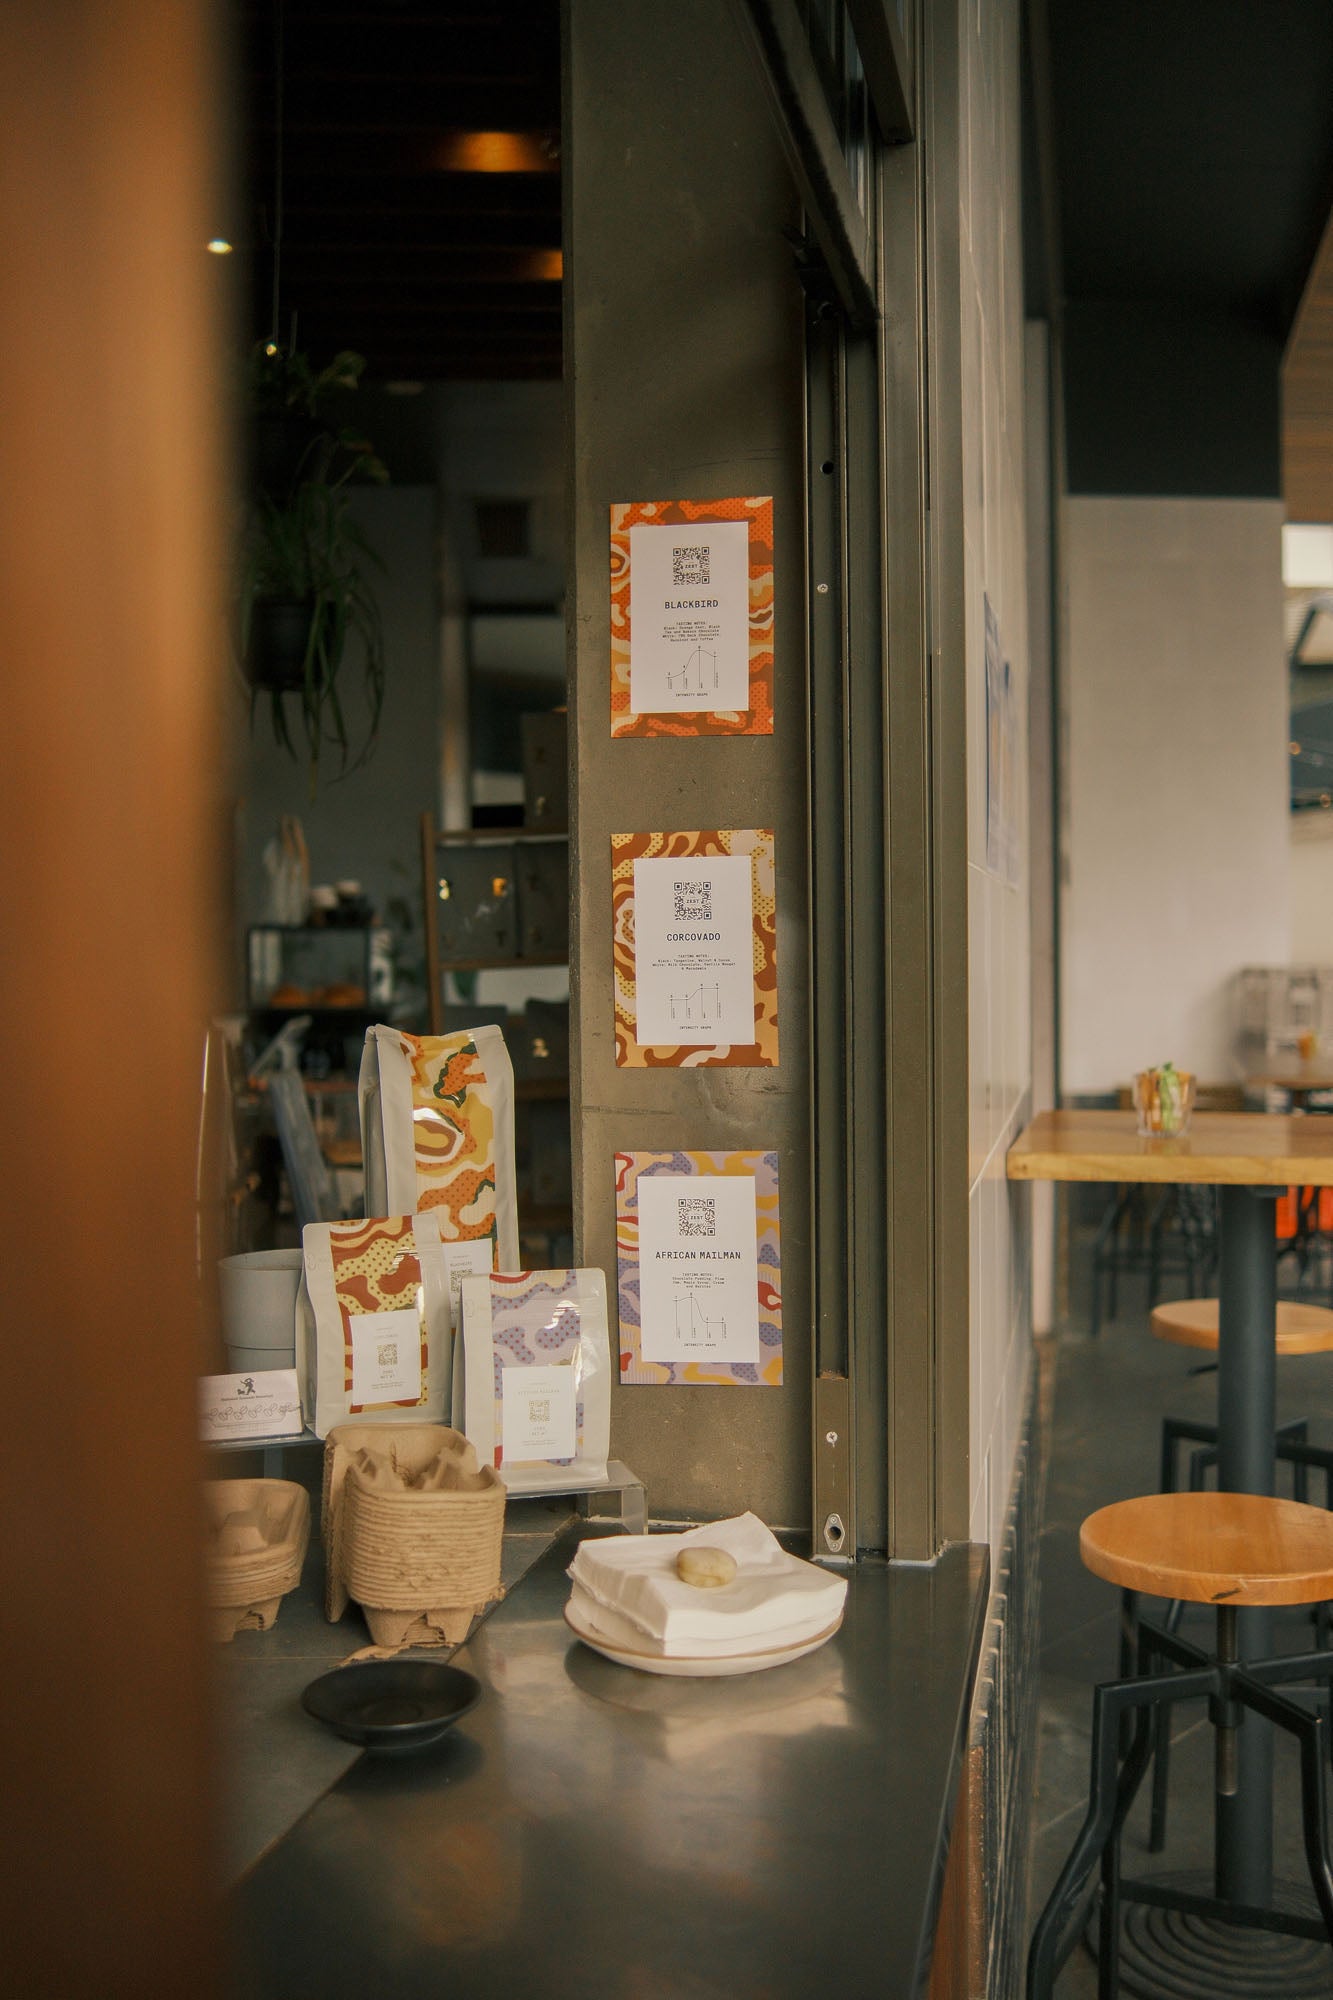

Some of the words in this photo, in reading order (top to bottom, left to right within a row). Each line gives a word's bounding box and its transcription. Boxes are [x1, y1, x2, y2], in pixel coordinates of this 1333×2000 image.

[664, 600, 719, 609] BLACKBIRD
[666, 933, 721, 941] CORCOVADO
[655, 1251, 696, 1259] AFRICAN
[700, 1251, 741, 1259] MAILMAN
